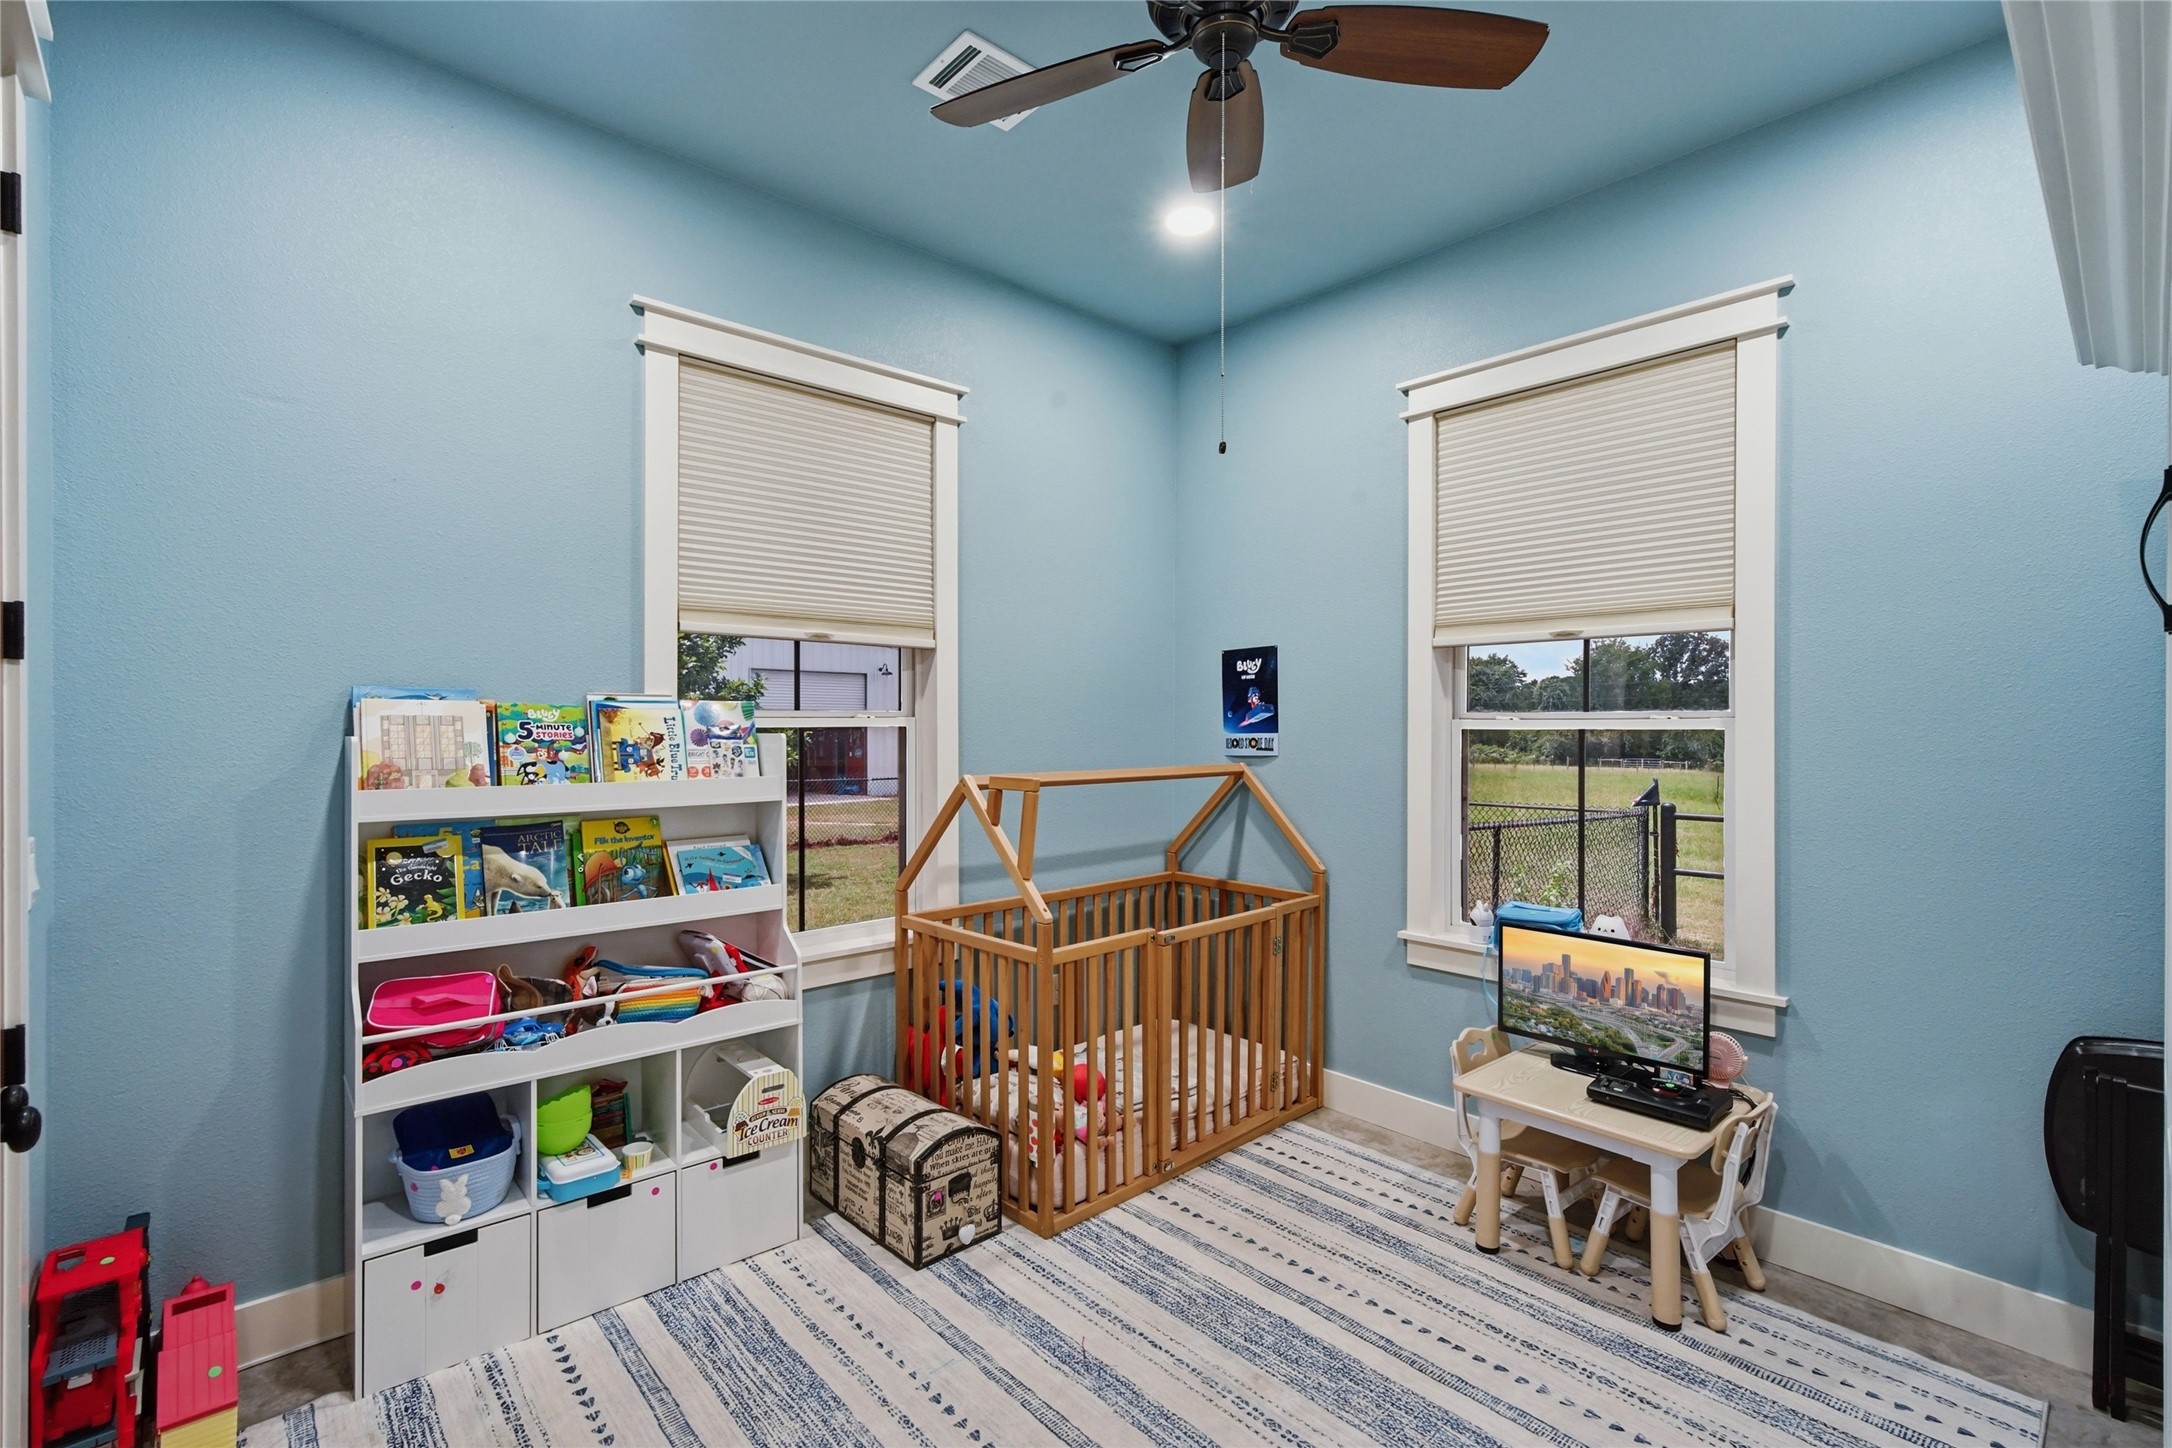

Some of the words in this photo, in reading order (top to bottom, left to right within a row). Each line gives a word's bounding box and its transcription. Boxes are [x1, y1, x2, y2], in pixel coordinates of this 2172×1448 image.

[663, 716, 677, 742] Little
[668, 743, 681, 763] Blue
[517, 830, 562, 843] ARCTIC
[517, 839, 564, 855] TALE
[390, 869, 443, 885] Gecko
[739, 1124, 758, 1142] Ice
[759, 1116, 798, 1132] Cream
[747, 1128, 788, 1146] COUNTER
[964, 1142, 976, 1151] me
[929, 1159, 950, 1172] When
[951, 1152, 970, 1164] skies
[971, 1148, 983, 1158] are
